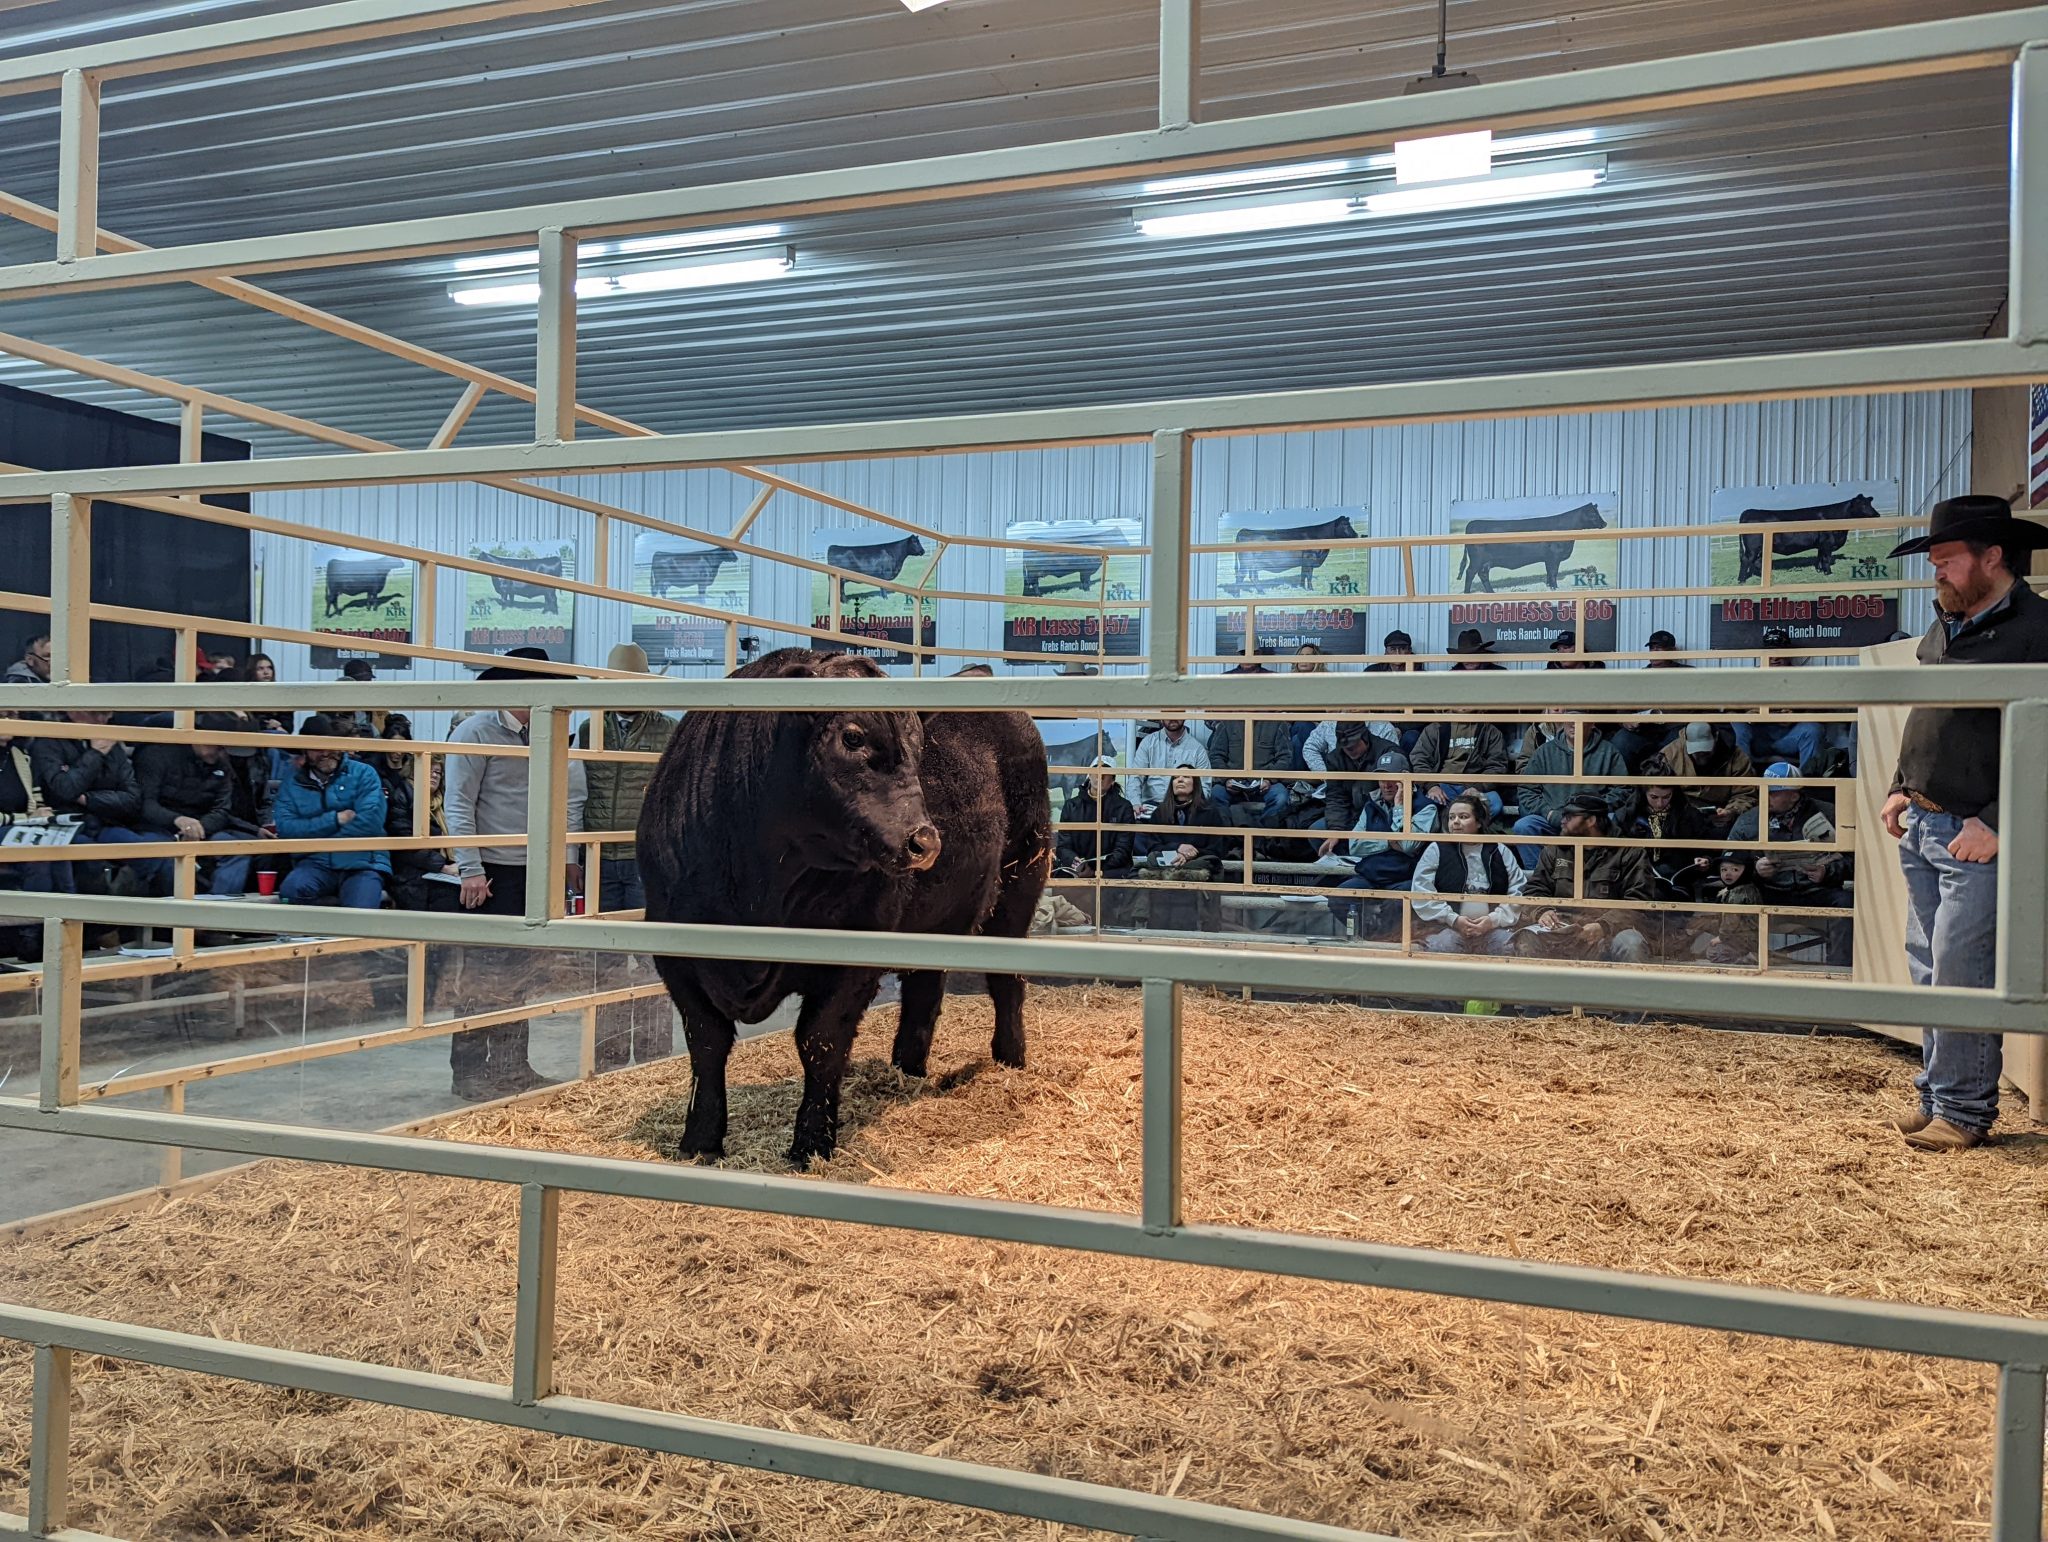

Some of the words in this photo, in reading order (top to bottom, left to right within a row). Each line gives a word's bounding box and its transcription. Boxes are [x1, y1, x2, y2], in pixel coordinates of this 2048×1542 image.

[1452, 600, 1553, 624] DUTCHESS
[1722, 598, 1754, 621] KR
[1759, 597, 1811, 620] Elba
[1816, 594, 1885, 619] 5065
[1301, 608, 1354, 630] 4343
[1013, 616, 1036, 637] KR
[1040, 615, 1081, 636] Lass
[1788, 625, 1815, 638] Ranch
[1816, 625, 1842, 637] Donor
[1278, 635, 1299, 647] Ranch
[1496, 628, 1517, 641] Krebs
[1518, 628, 1541, 640] Ranch
[680, 647, 698, 657] Ranch
[1041, 640, 1058, 652] Krebs
[1060, 639, 1079, 651] Ranch
[1080, 639, 1098, 651] Donor
[863, 647, 880, 658] Ranch
